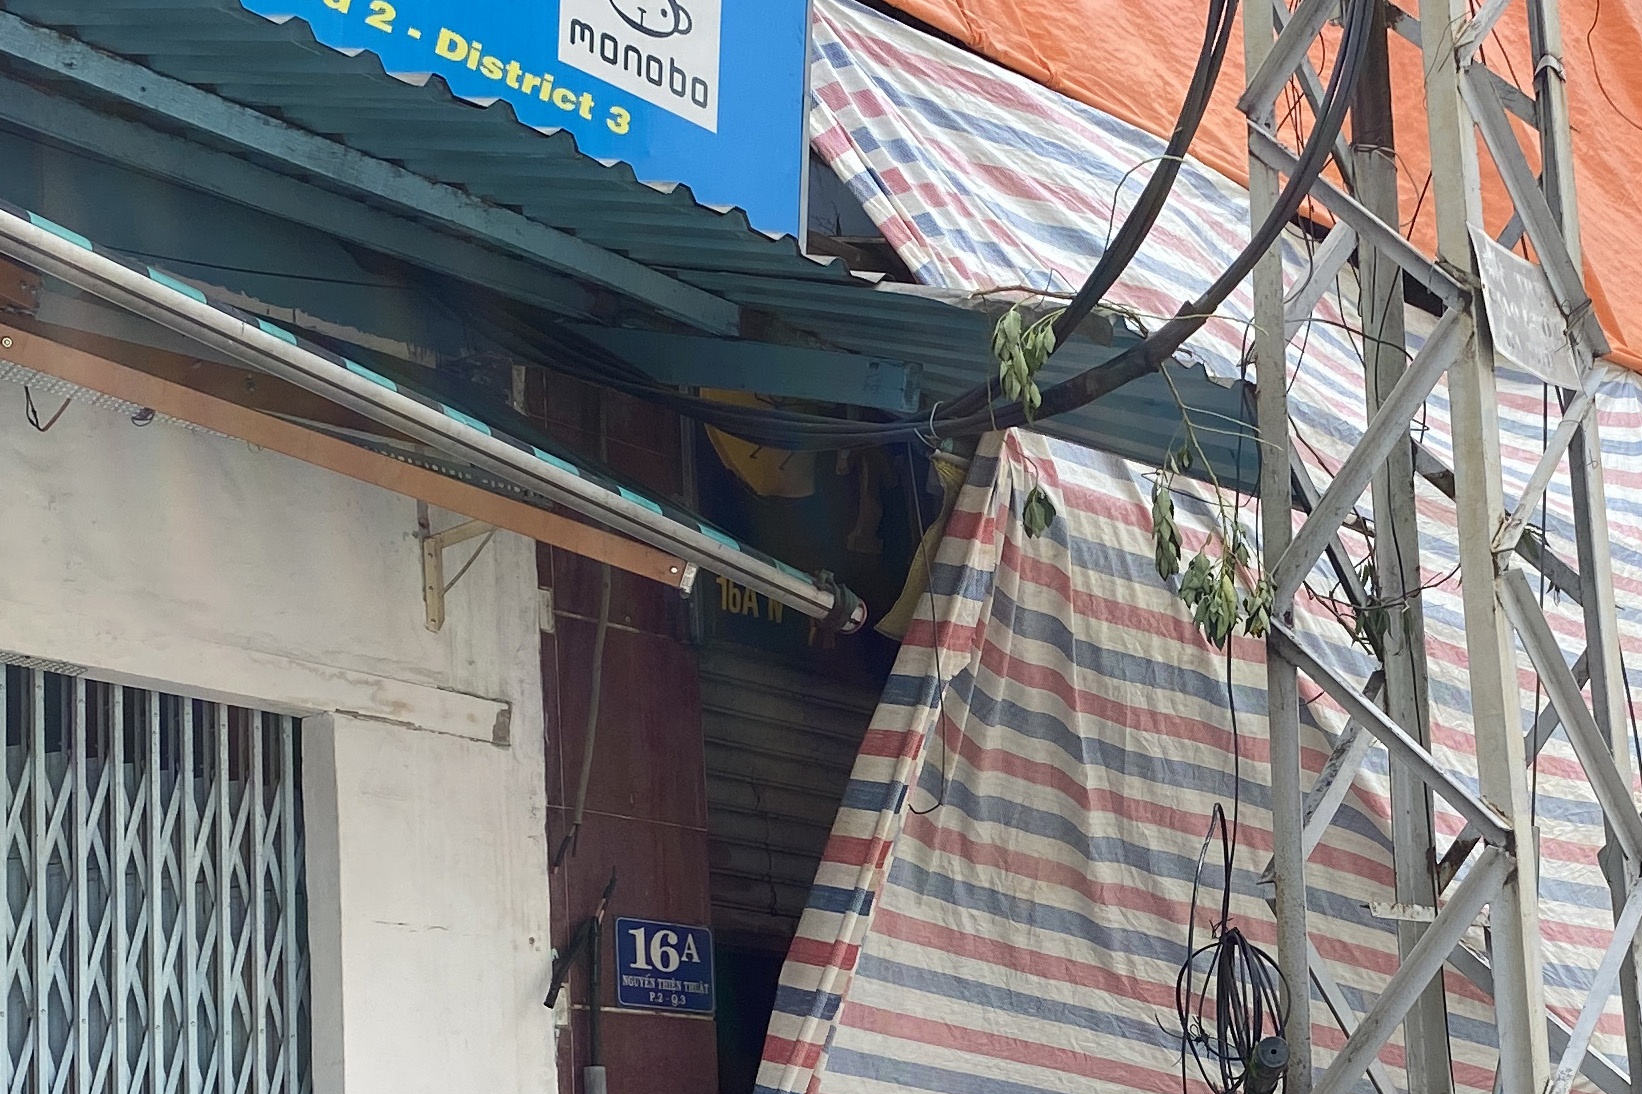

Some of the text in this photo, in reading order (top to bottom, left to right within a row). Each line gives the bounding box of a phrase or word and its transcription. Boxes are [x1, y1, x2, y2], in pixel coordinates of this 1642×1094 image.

[365, 0, 398, 34] 2
[434, 27, 596, 121] District
[605, 105, 632, 135] 3
[569, 18, 709, 109] monobo
[628, 926, 701, 973] 16A
[649, 991, 664, 1003] P.2
